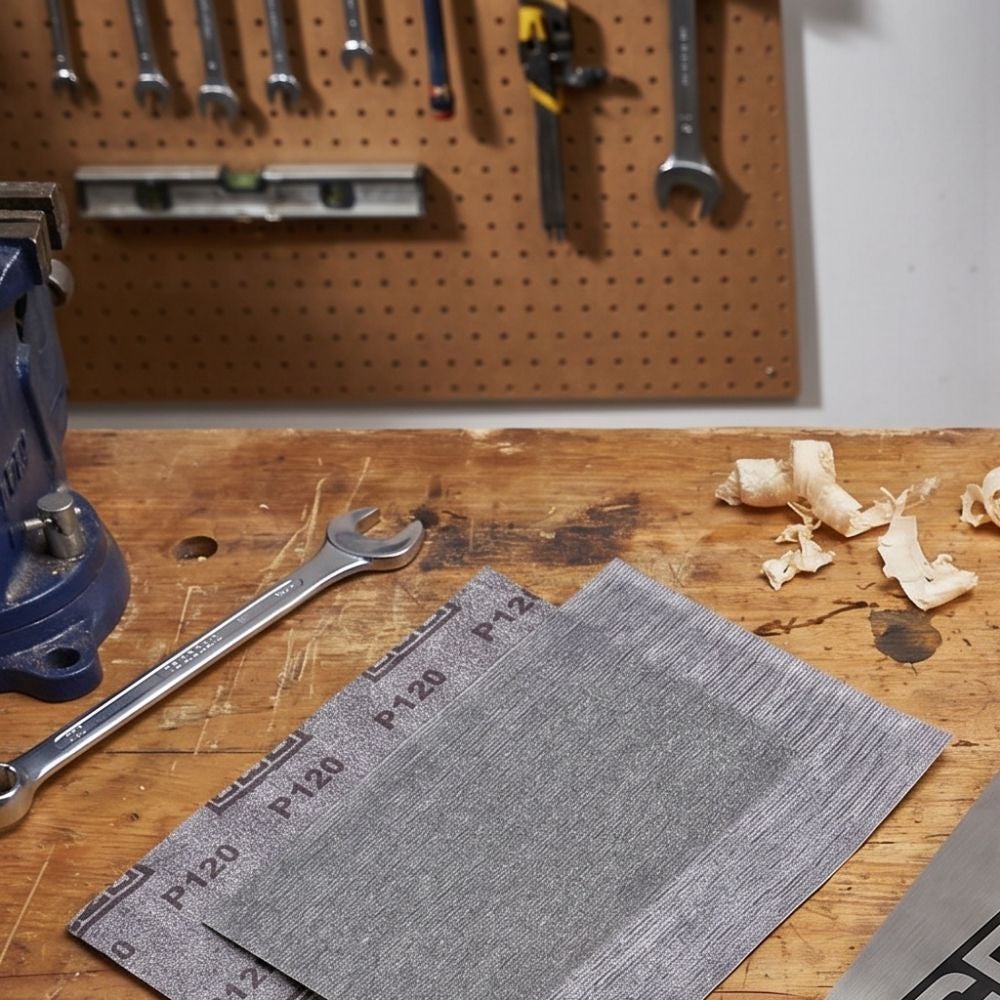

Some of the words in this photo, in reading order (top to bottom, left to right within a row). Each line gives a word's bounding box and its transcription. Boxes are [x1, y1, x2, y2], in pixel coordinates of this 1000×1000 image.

[471, 590, 542, 642] P12
[373, 669, 447, 731] P120
[267, 756, 344, 819] P120
[160, 844, 240, 911] P120
